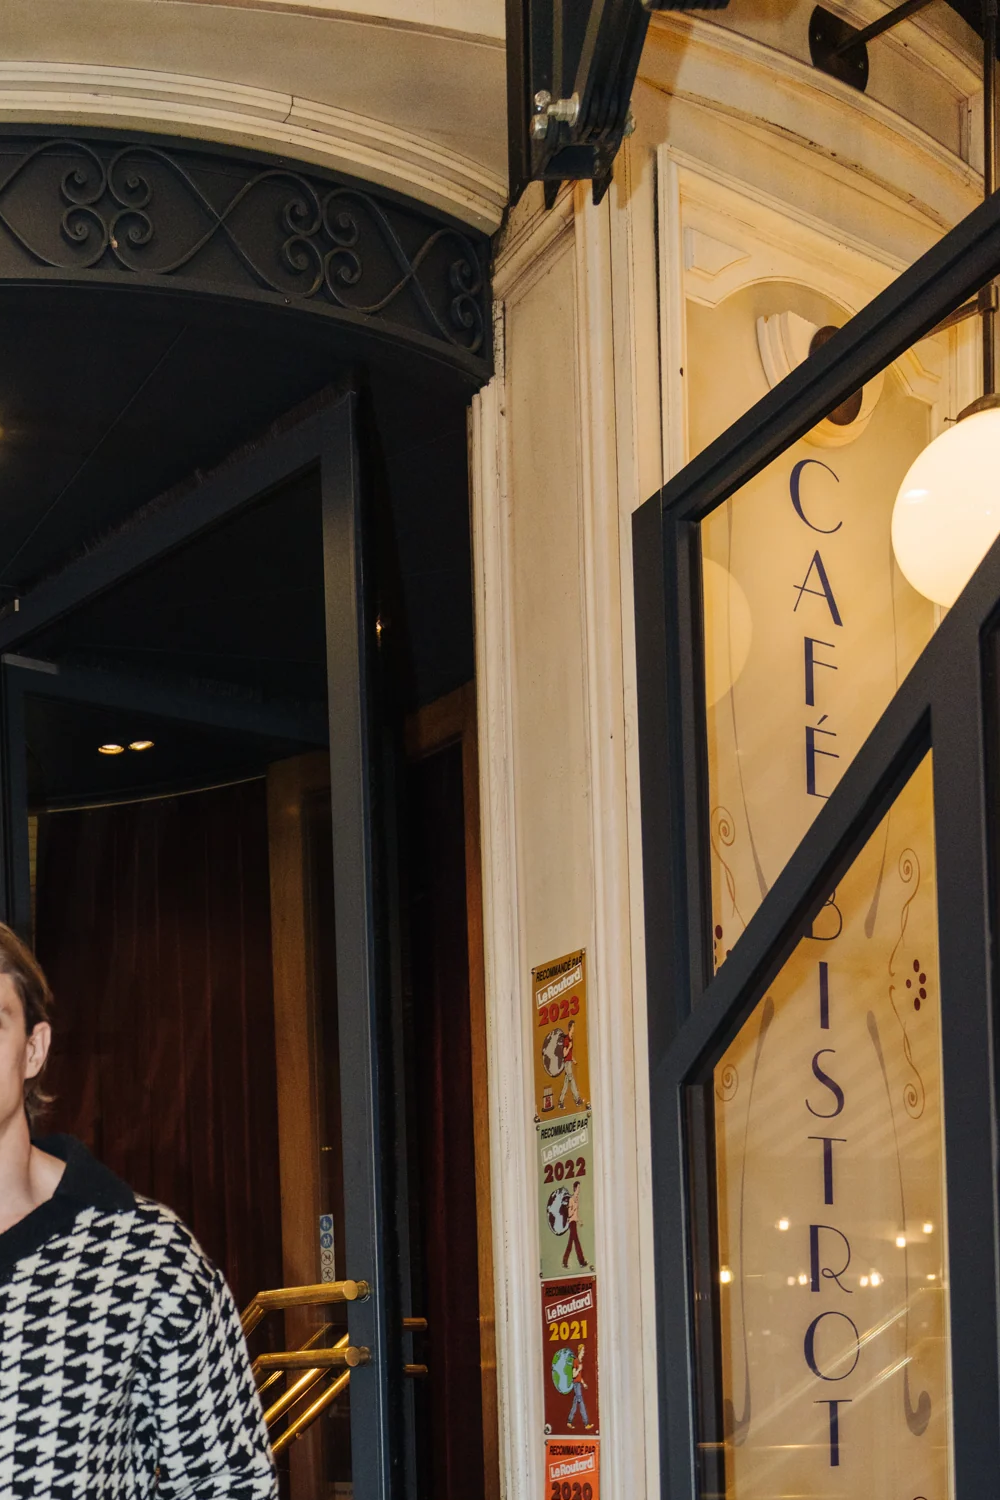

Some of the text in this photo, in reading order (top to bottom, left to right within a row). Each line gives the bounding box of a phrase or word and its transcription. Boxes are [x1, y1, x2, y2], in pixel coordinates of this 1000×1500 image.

[536, 958, 571, 982] RECOMMANDÉ
[789, 458, 860, 1467] CAFÉ BISTROT
[537, 967, 581, 1005] Le Routard
[538, 995, 580, 1027] 2023
[541, 1118, 588, 1140] RECOMMANDÉ PAR
[552, 1131, 586, 1159] Routard
[543, 1157, 586, 1184] 2022
[547, 1293, 591, 1320] Le Routard
[548, 1320, 588, 1341] 2021
[550, 1455, 593, 1478] Le Routard
